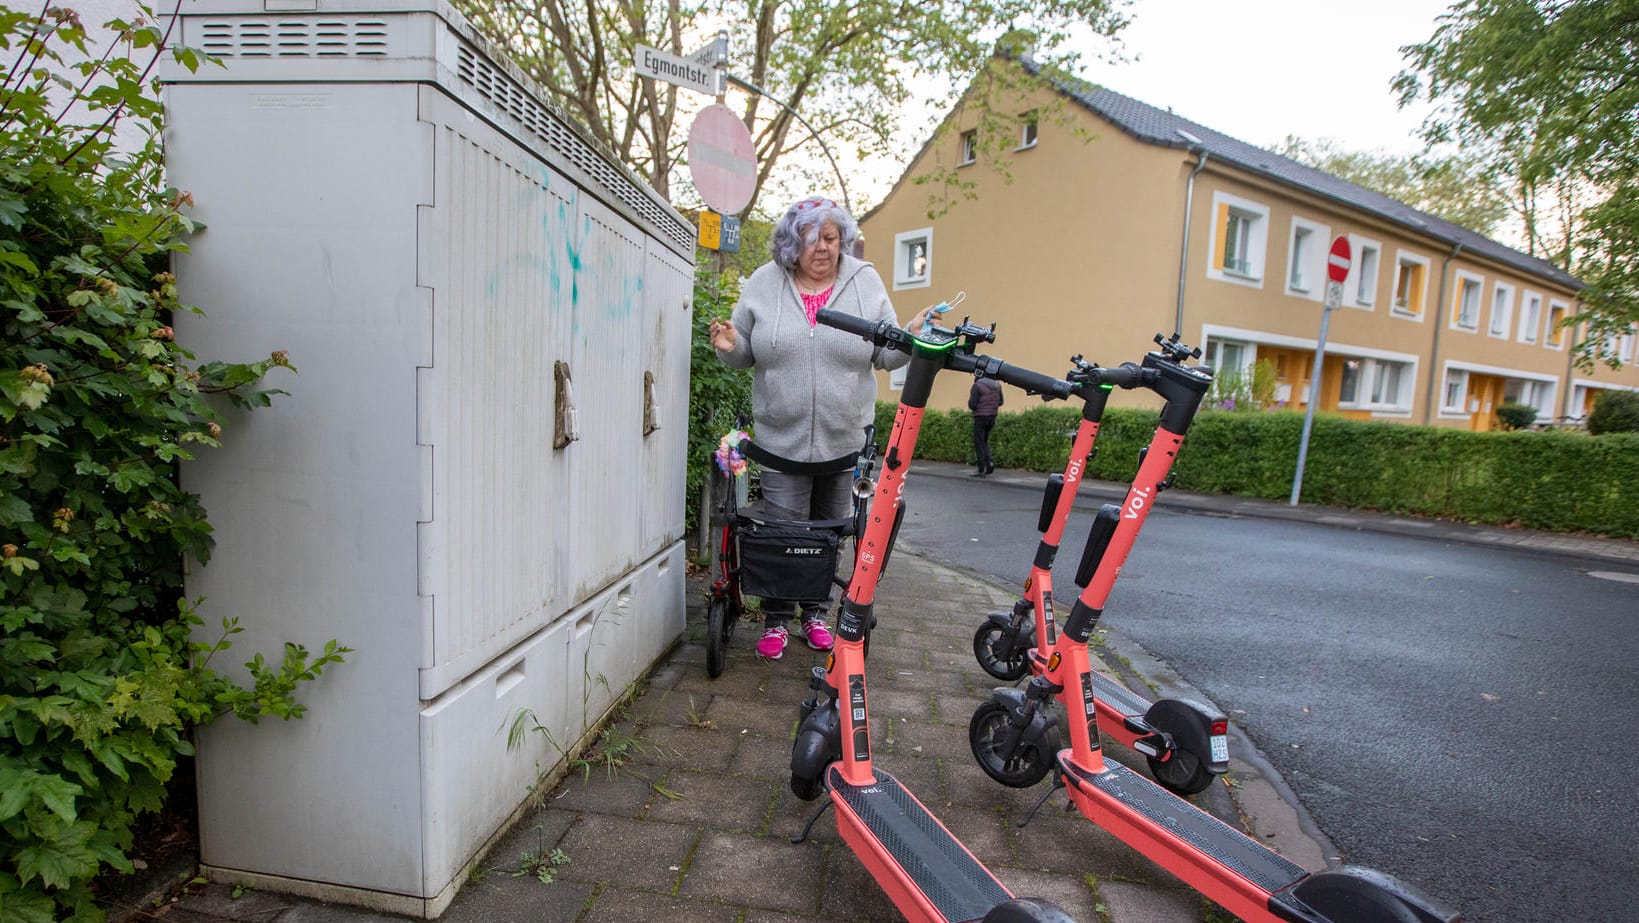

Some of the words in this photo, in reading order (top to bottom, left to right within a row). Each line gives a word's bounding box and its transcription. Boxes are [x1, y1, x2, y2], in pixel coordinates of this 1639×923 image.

[644, 50, 709, 87] Egmontstr.
[1067, 458, 1082, 483] voi.
[1125, 486, 1151, 519] voi.
[840, 623, 858, 634] DEVK
[861, 786, 882, 795] voi.
